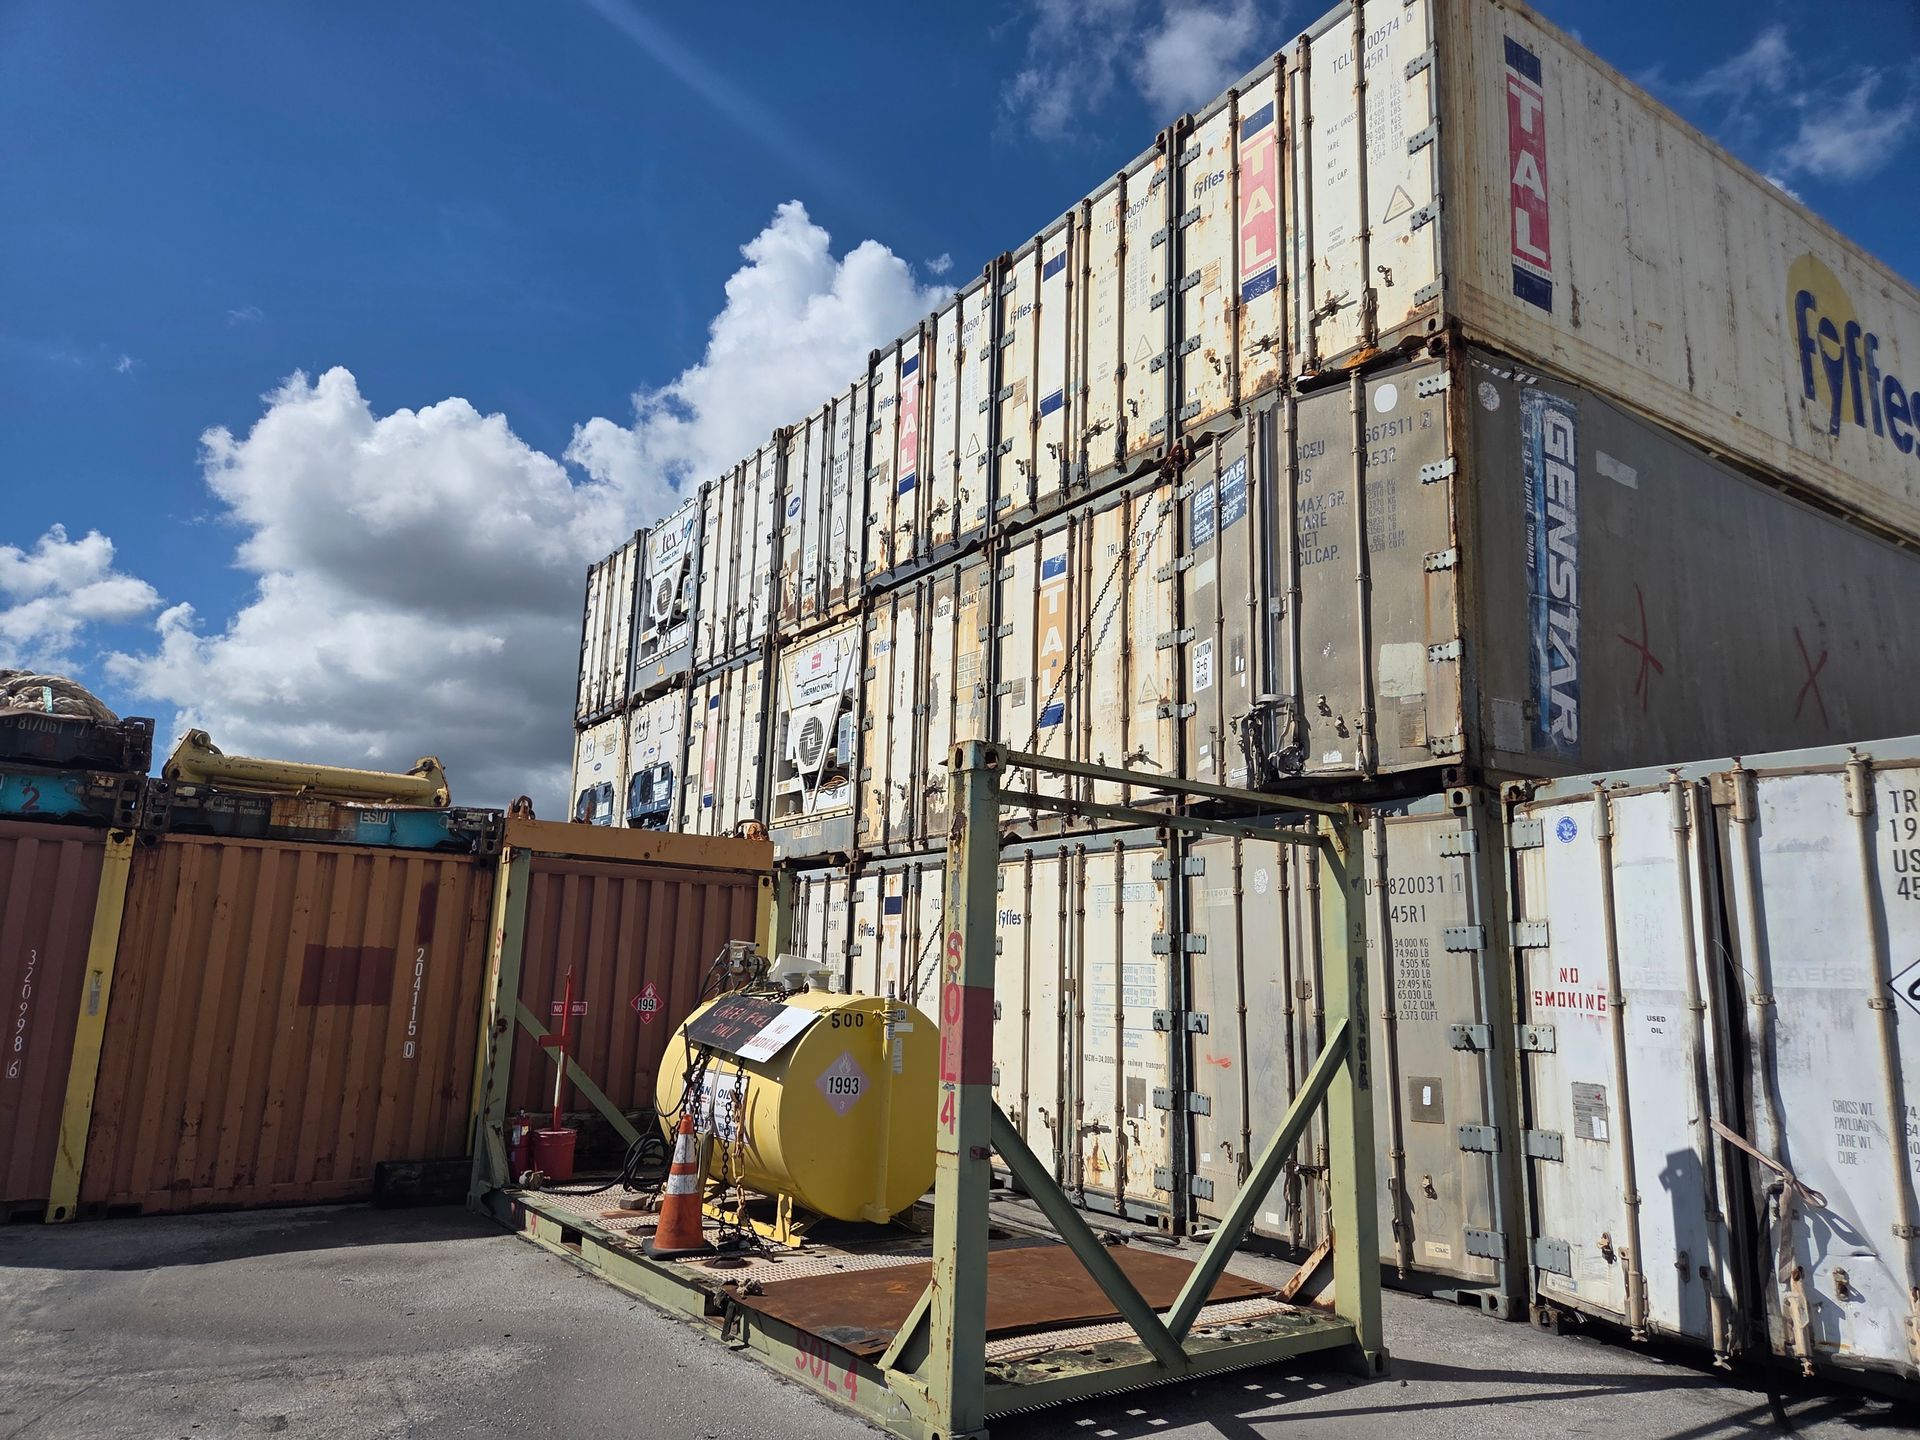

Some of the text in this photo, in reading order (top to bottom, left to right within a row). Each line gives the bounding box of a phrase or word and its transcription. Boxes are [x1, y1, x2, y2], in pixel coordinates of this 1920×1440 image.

[1366, 17, 1399, 49] 00574
[1364, 44, 1389, 70] 45R1
[1327, 124, 1338, 136] MAX
[1327, 140, 1340, 153] TARE
[1327, 158, 1337, 170] NET
[1508, 80, 1546, 262] TAL
[1193, 168, 1225, 200] fyffes
[1126, 194, 1149, 219] 00599
[1242, 134, 1275, 270] TAL
[1010, 302, 1032, 326] fyffes
[947, 315, 980, 346] TCL 00500
[901, 382, 918, 471] TAL
[1366, 446, 1397, 468] 4532
[1524, 475, 1534, 515] Capital
[1297, 511, 1328, 533] TARE
[1297, 531, 1318, 549] NET
[1525, 523, 1536, 569] Company
[1544, 406, 1579, 746] GENSTAR
[1041, 583, 1065, 699] TAL
[1194, 640, 1212, 660] CAUTION
[1195, 656, 1208, 674] 9-6
[821, 680, 833, 691] KING
[22, 786, 41, 812] 2
[1888, 788, 1920, 814] TR
[361, 810, 389, 825] ESIU
[1389, 875, 1444, 895] 820031
[815, 902, 823, 914] TCL
[1390, 904, 1427, 923] 45R1
[998, 908, 1022, 928] fyffes
[858, 922, 875, 939] fyffes
[1419, 938, 1429, 948] KG
[1420, 948, 1430, 958] LB
[1400, 958, 1431, 969] 4.505 KG
[1400, 968, 1431, 979] 9.930 LB
[1559, 967, 1579, 984] NO
[407, 947, 425, 1037] 204115
[1397, 979, 1432, 989] 29.495 KG
[13, 949, 37, 1052] 320998
[1397, 989, 1433, 1000] 65.030 LB
[1534, 990, 1607, 1012] SMOKING
[553, 1003, 584, 1013] NO KING
[940, 930, 964, 1083] SOL
[743, 1011, 772, 1029] FUEL
[831, 1012, 864, 1029] 500
[1646, 1015, 1666, 1023] USED
[711, 1022, 743, 1040] ONLY
[772, 1023, 791, 1035] NO
[1650, 1027, 1663, 1035] OIL
[745, 1033, 785, 1053] SMOKING
[1128, 1059, 1143, 1068] railway
[828, 1076, 860, 1095] 1993
[839, 1100, 845, 1110] 3
[940, 1090, 957, 1136] 4
[1832, 1098, 1858, 1115] GROSS
[1833, 1115, 1870, 1133] PAYLOAD
[1836, 1133, 1857, 1149] TARE
[1837, 1150, 1859, 1166] CUBE
[794, 1328, 859, 1403] SOL 4
